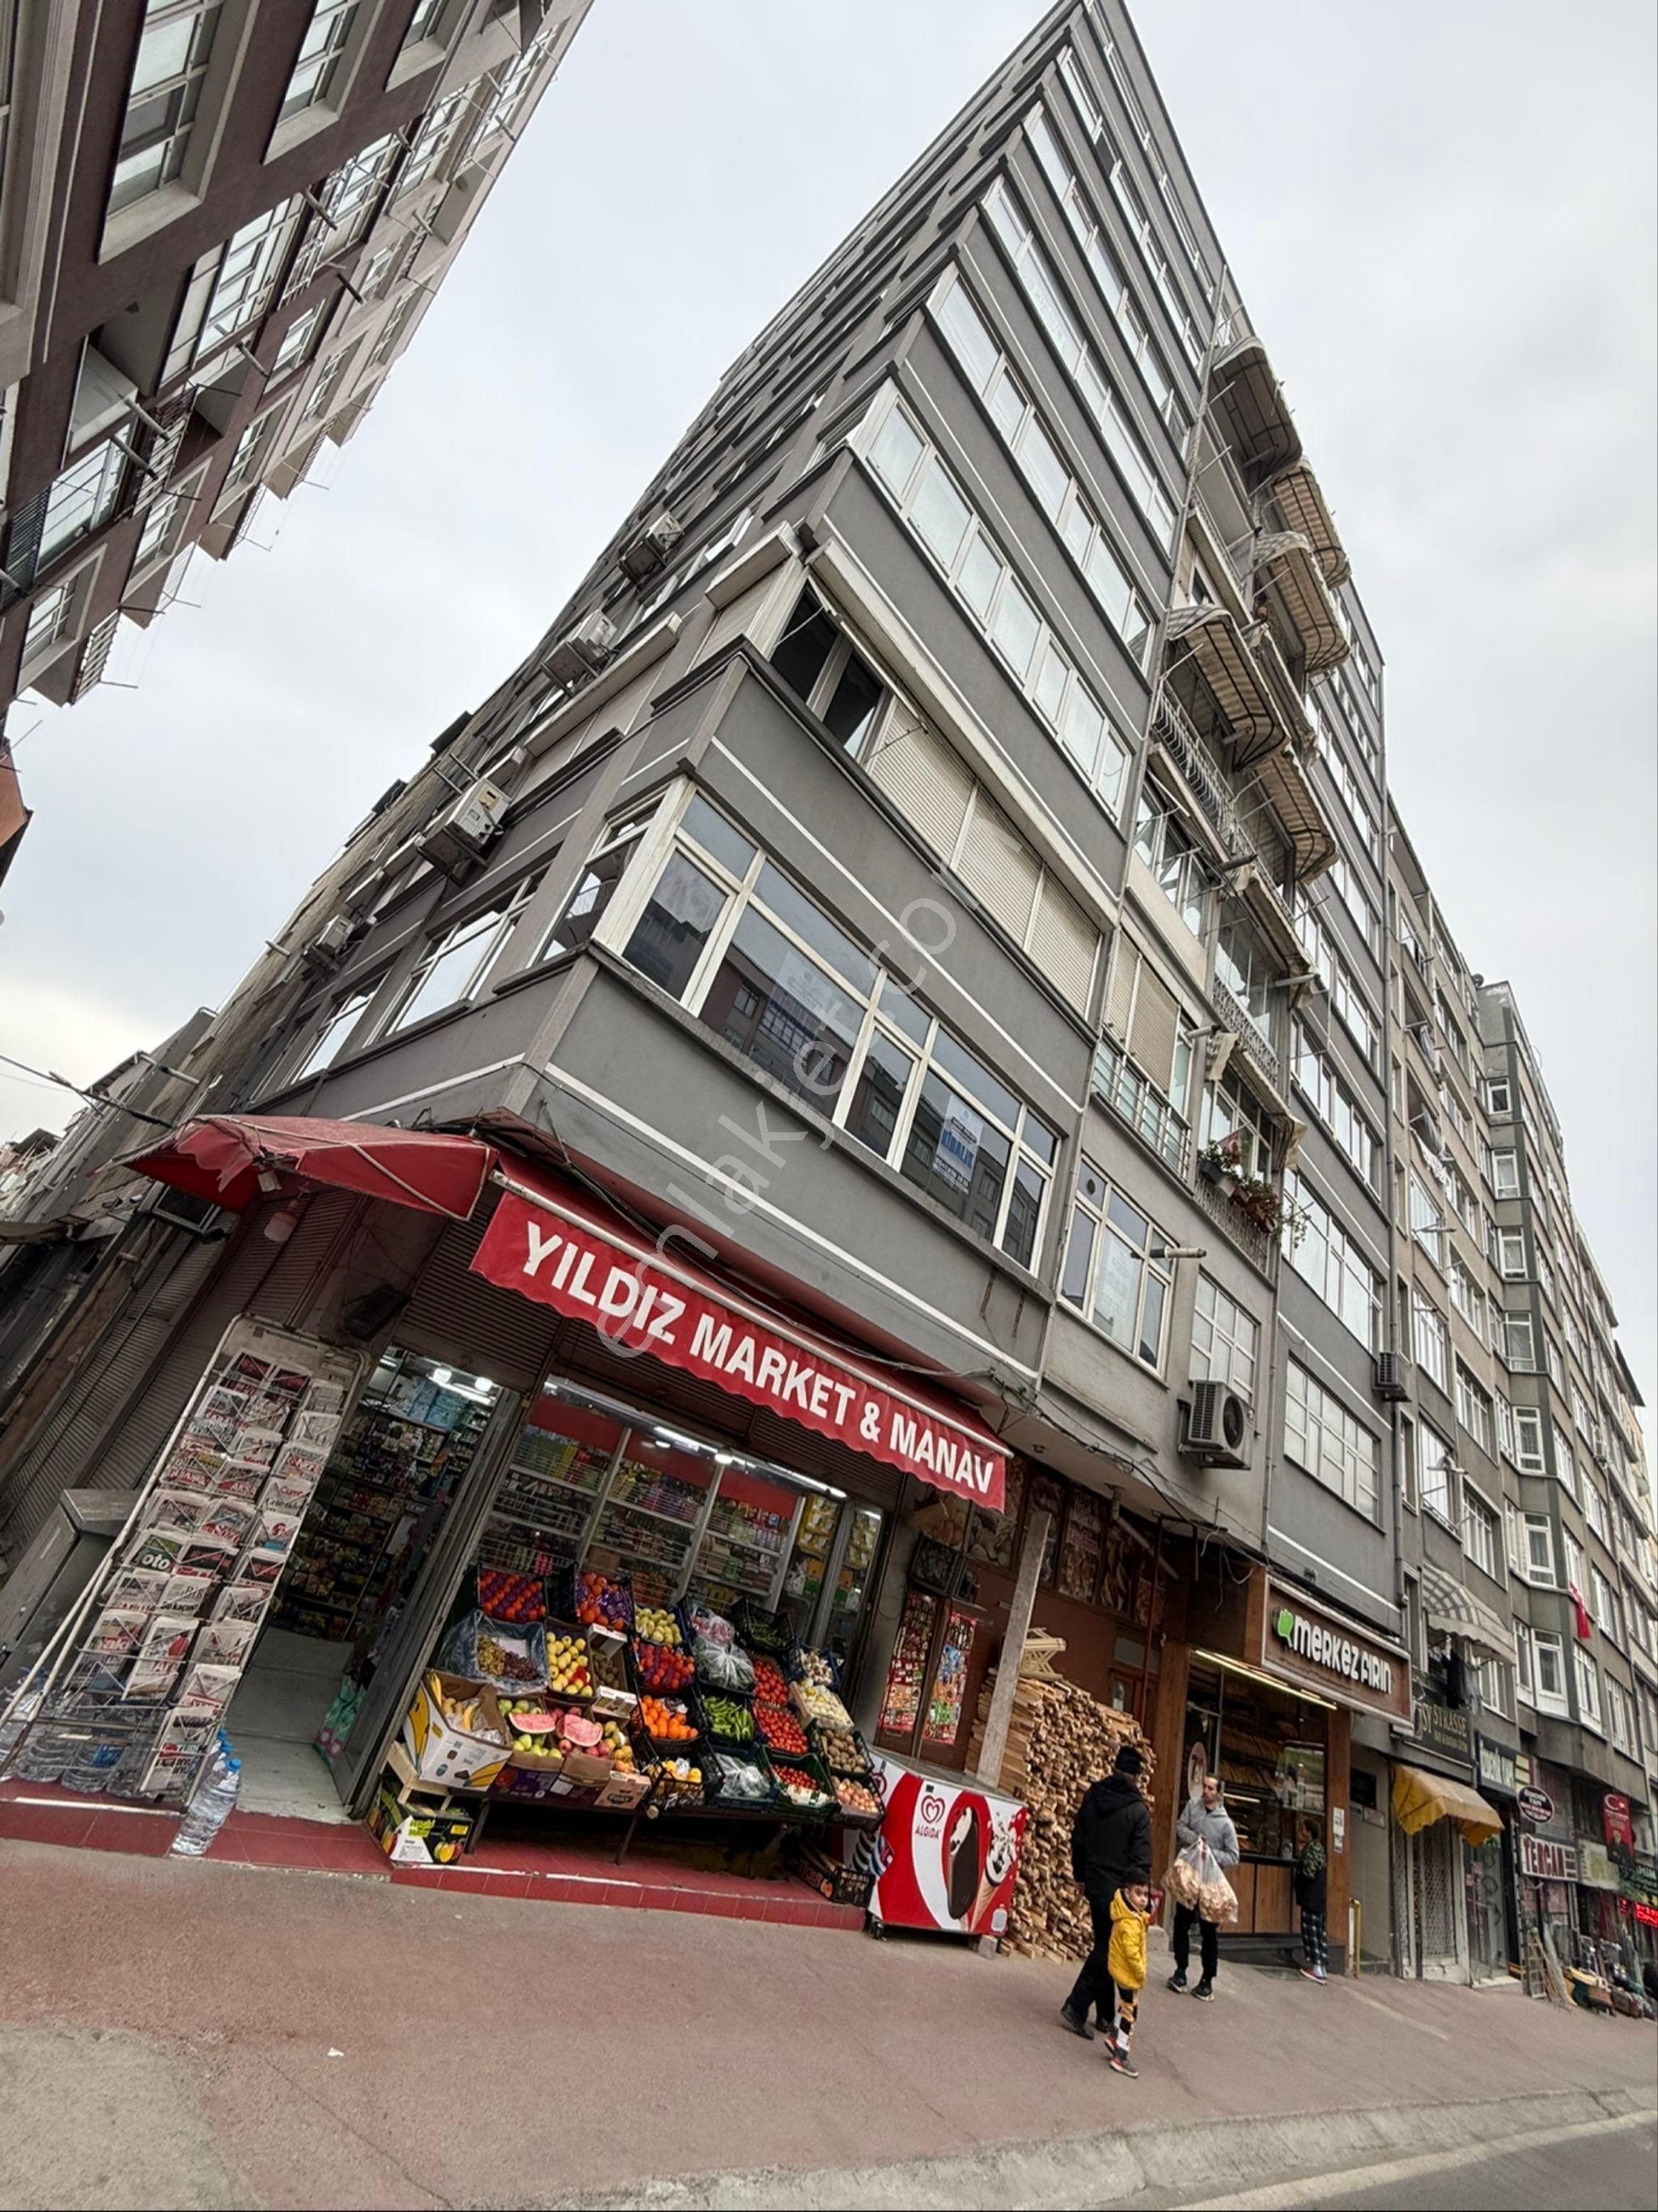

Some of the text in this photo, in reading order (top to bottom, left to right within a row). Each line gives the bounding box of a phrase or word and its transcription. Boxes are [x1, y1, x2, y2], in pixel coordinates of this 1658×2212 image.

[522, 1221, 994, 1494] YILDIZ MARKET & MANAV
[1523, 1836, 1566, 1878] TERCAN
